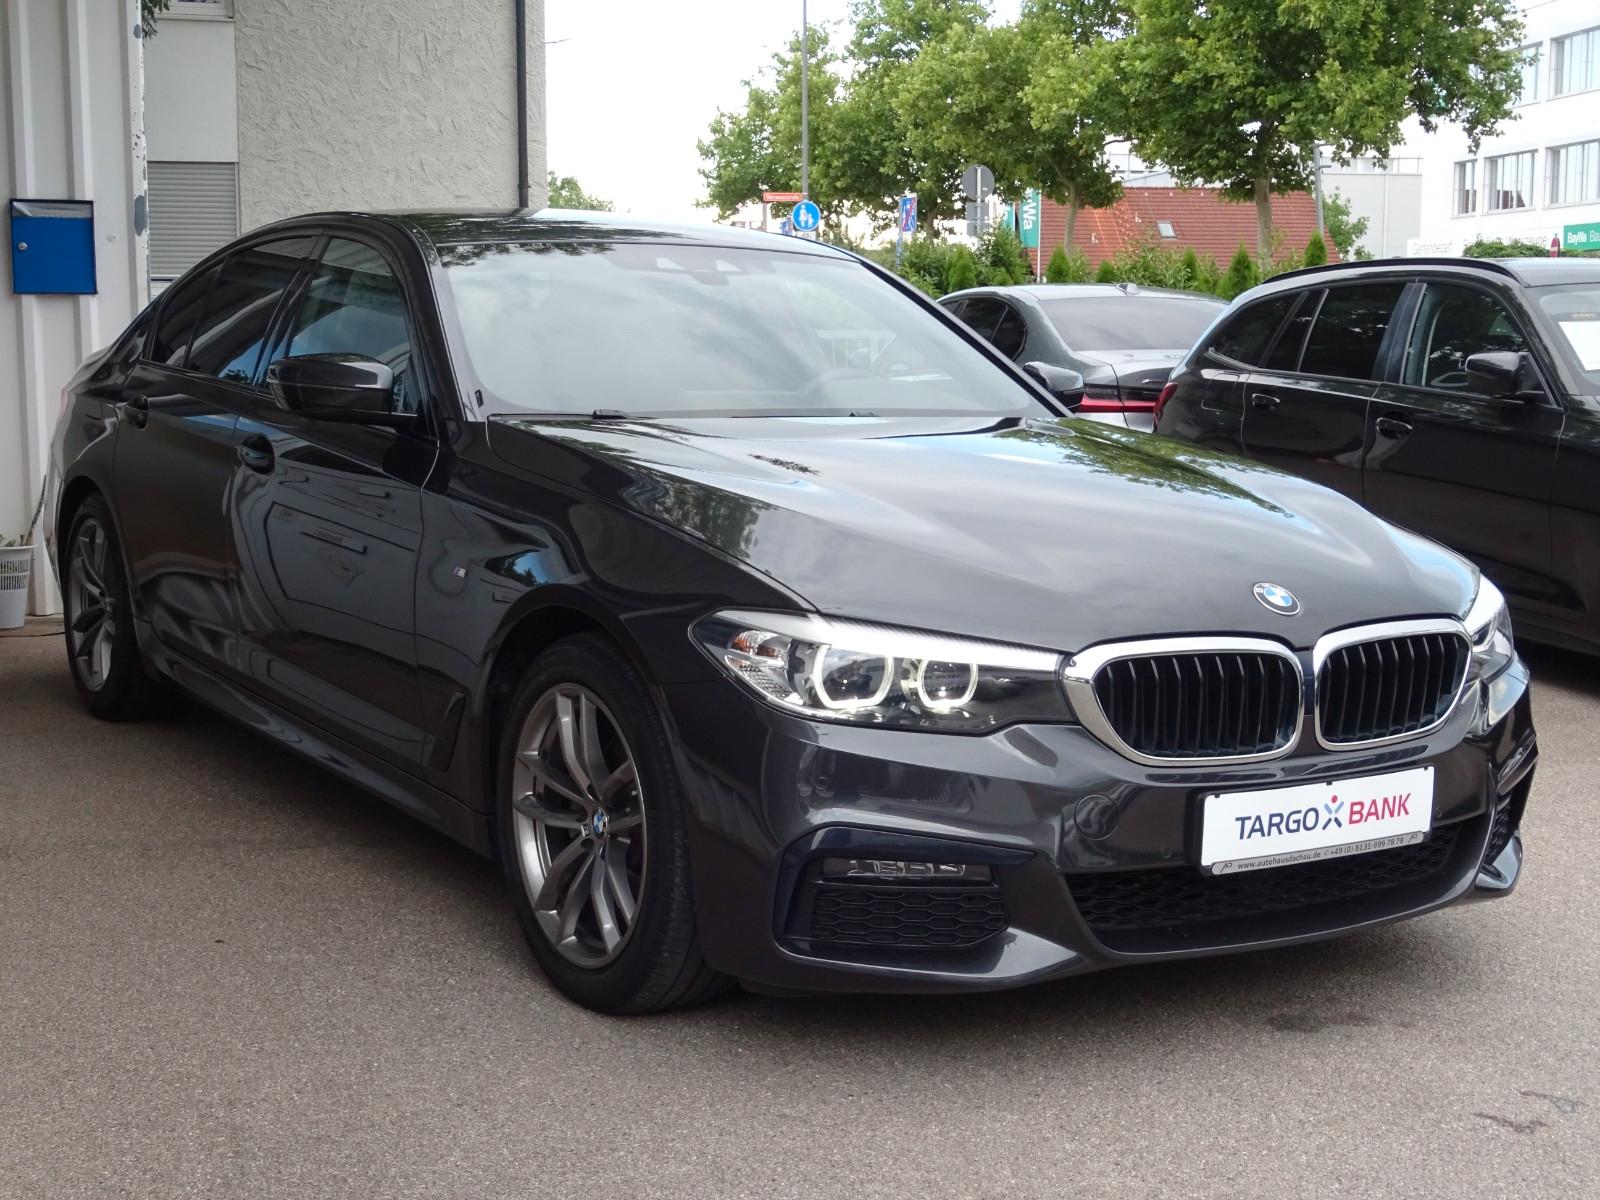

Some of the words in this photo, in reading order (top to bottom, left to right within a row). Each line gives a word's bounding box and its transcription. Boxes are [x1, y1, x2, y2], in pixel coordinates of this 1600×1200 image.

[1235, 807, 1320, 840] TARGO
[1348, 792, 1411, 825] BANK
[1237, 850, 1321, 870] www.autohausdachau.de
